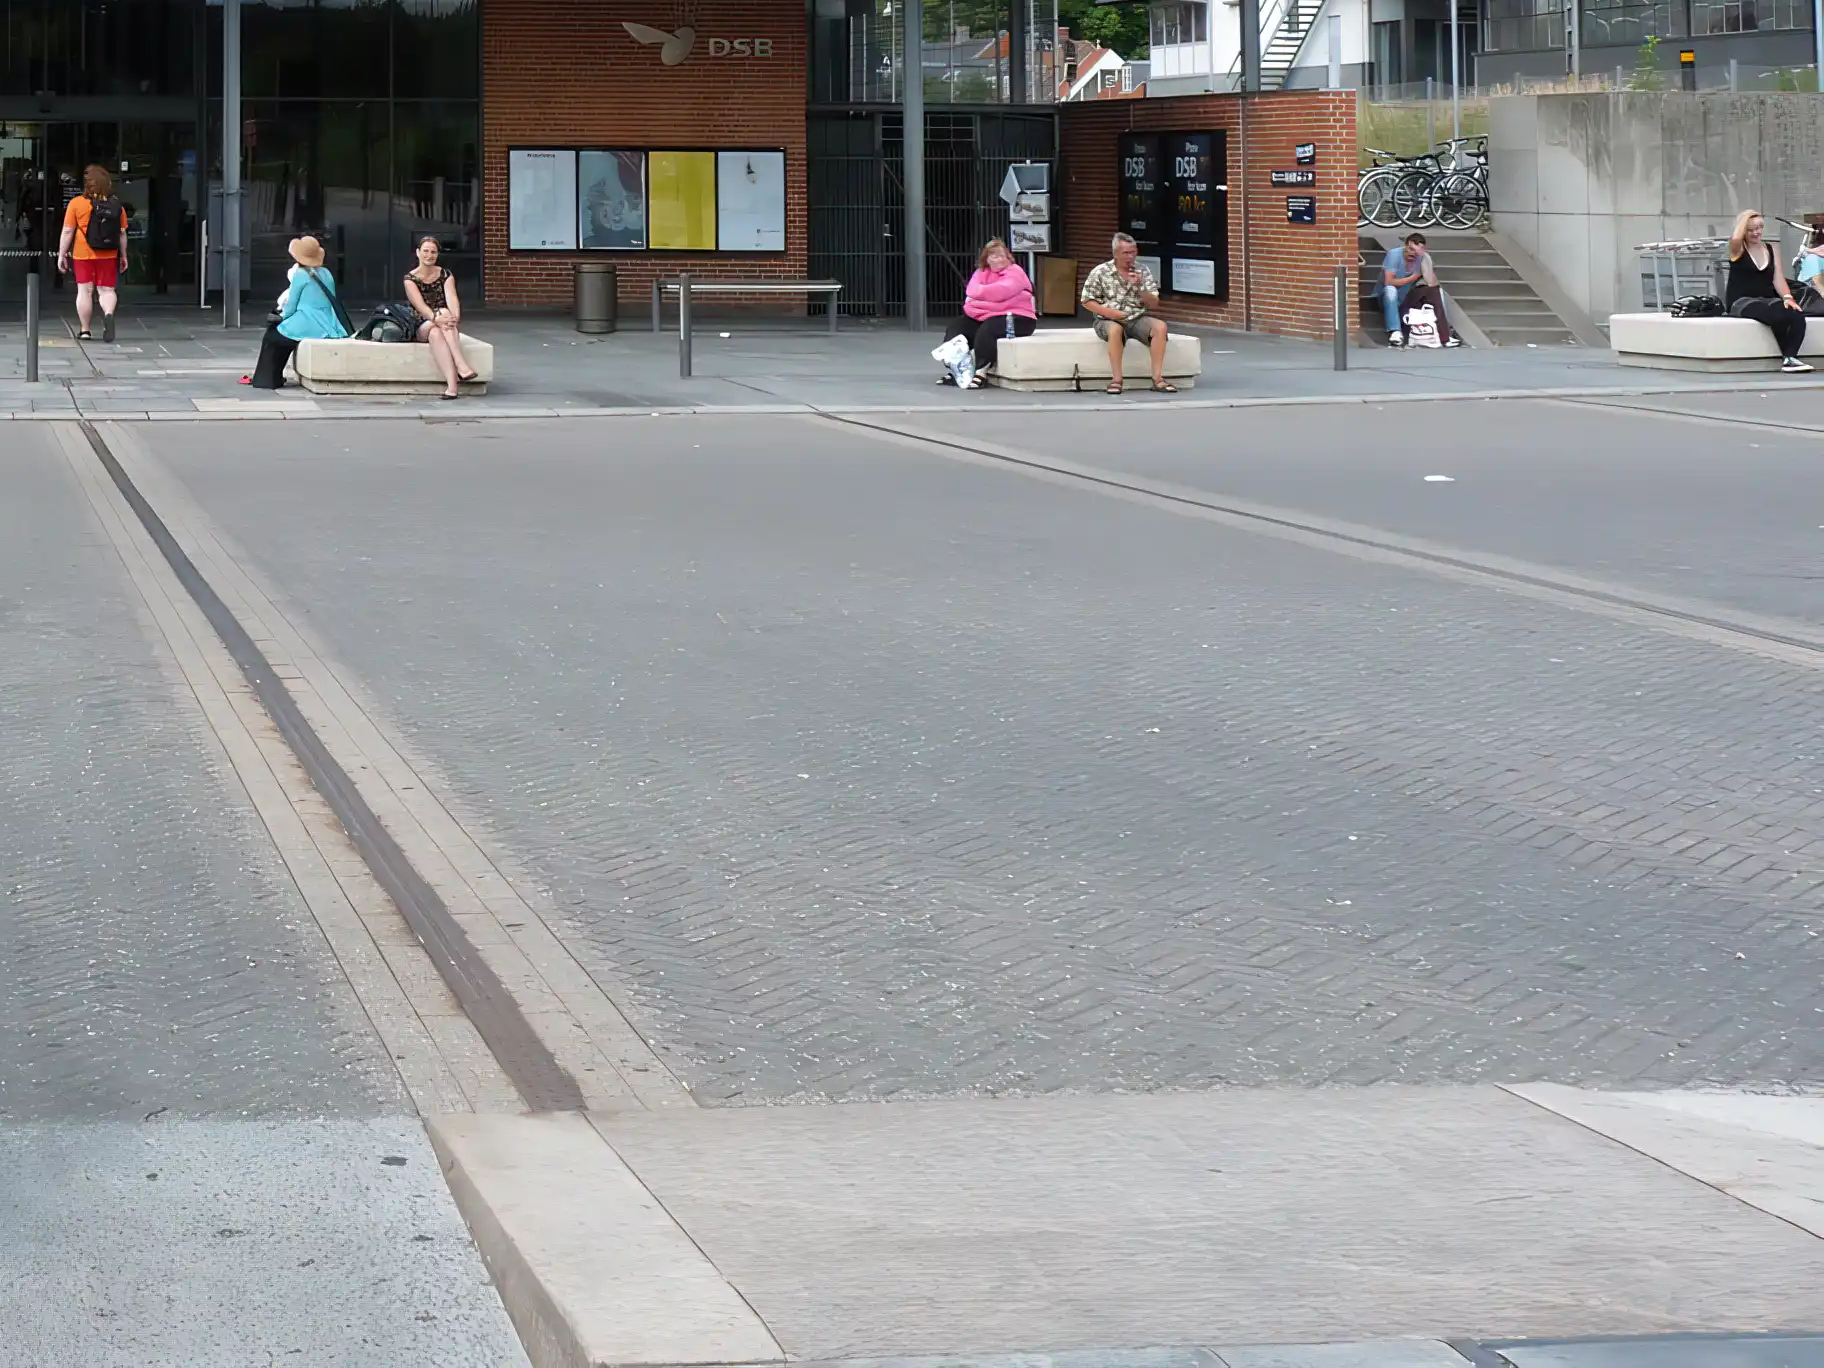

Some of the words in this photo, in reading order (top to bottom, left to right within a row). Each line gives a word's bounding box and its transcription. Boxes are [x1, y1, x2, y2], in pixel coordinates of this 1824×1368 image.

[709, 37, 773, 57] DSB
[1125, 157, 1145, 177] DSB
[1175, 156, 1197, 178] DSB
